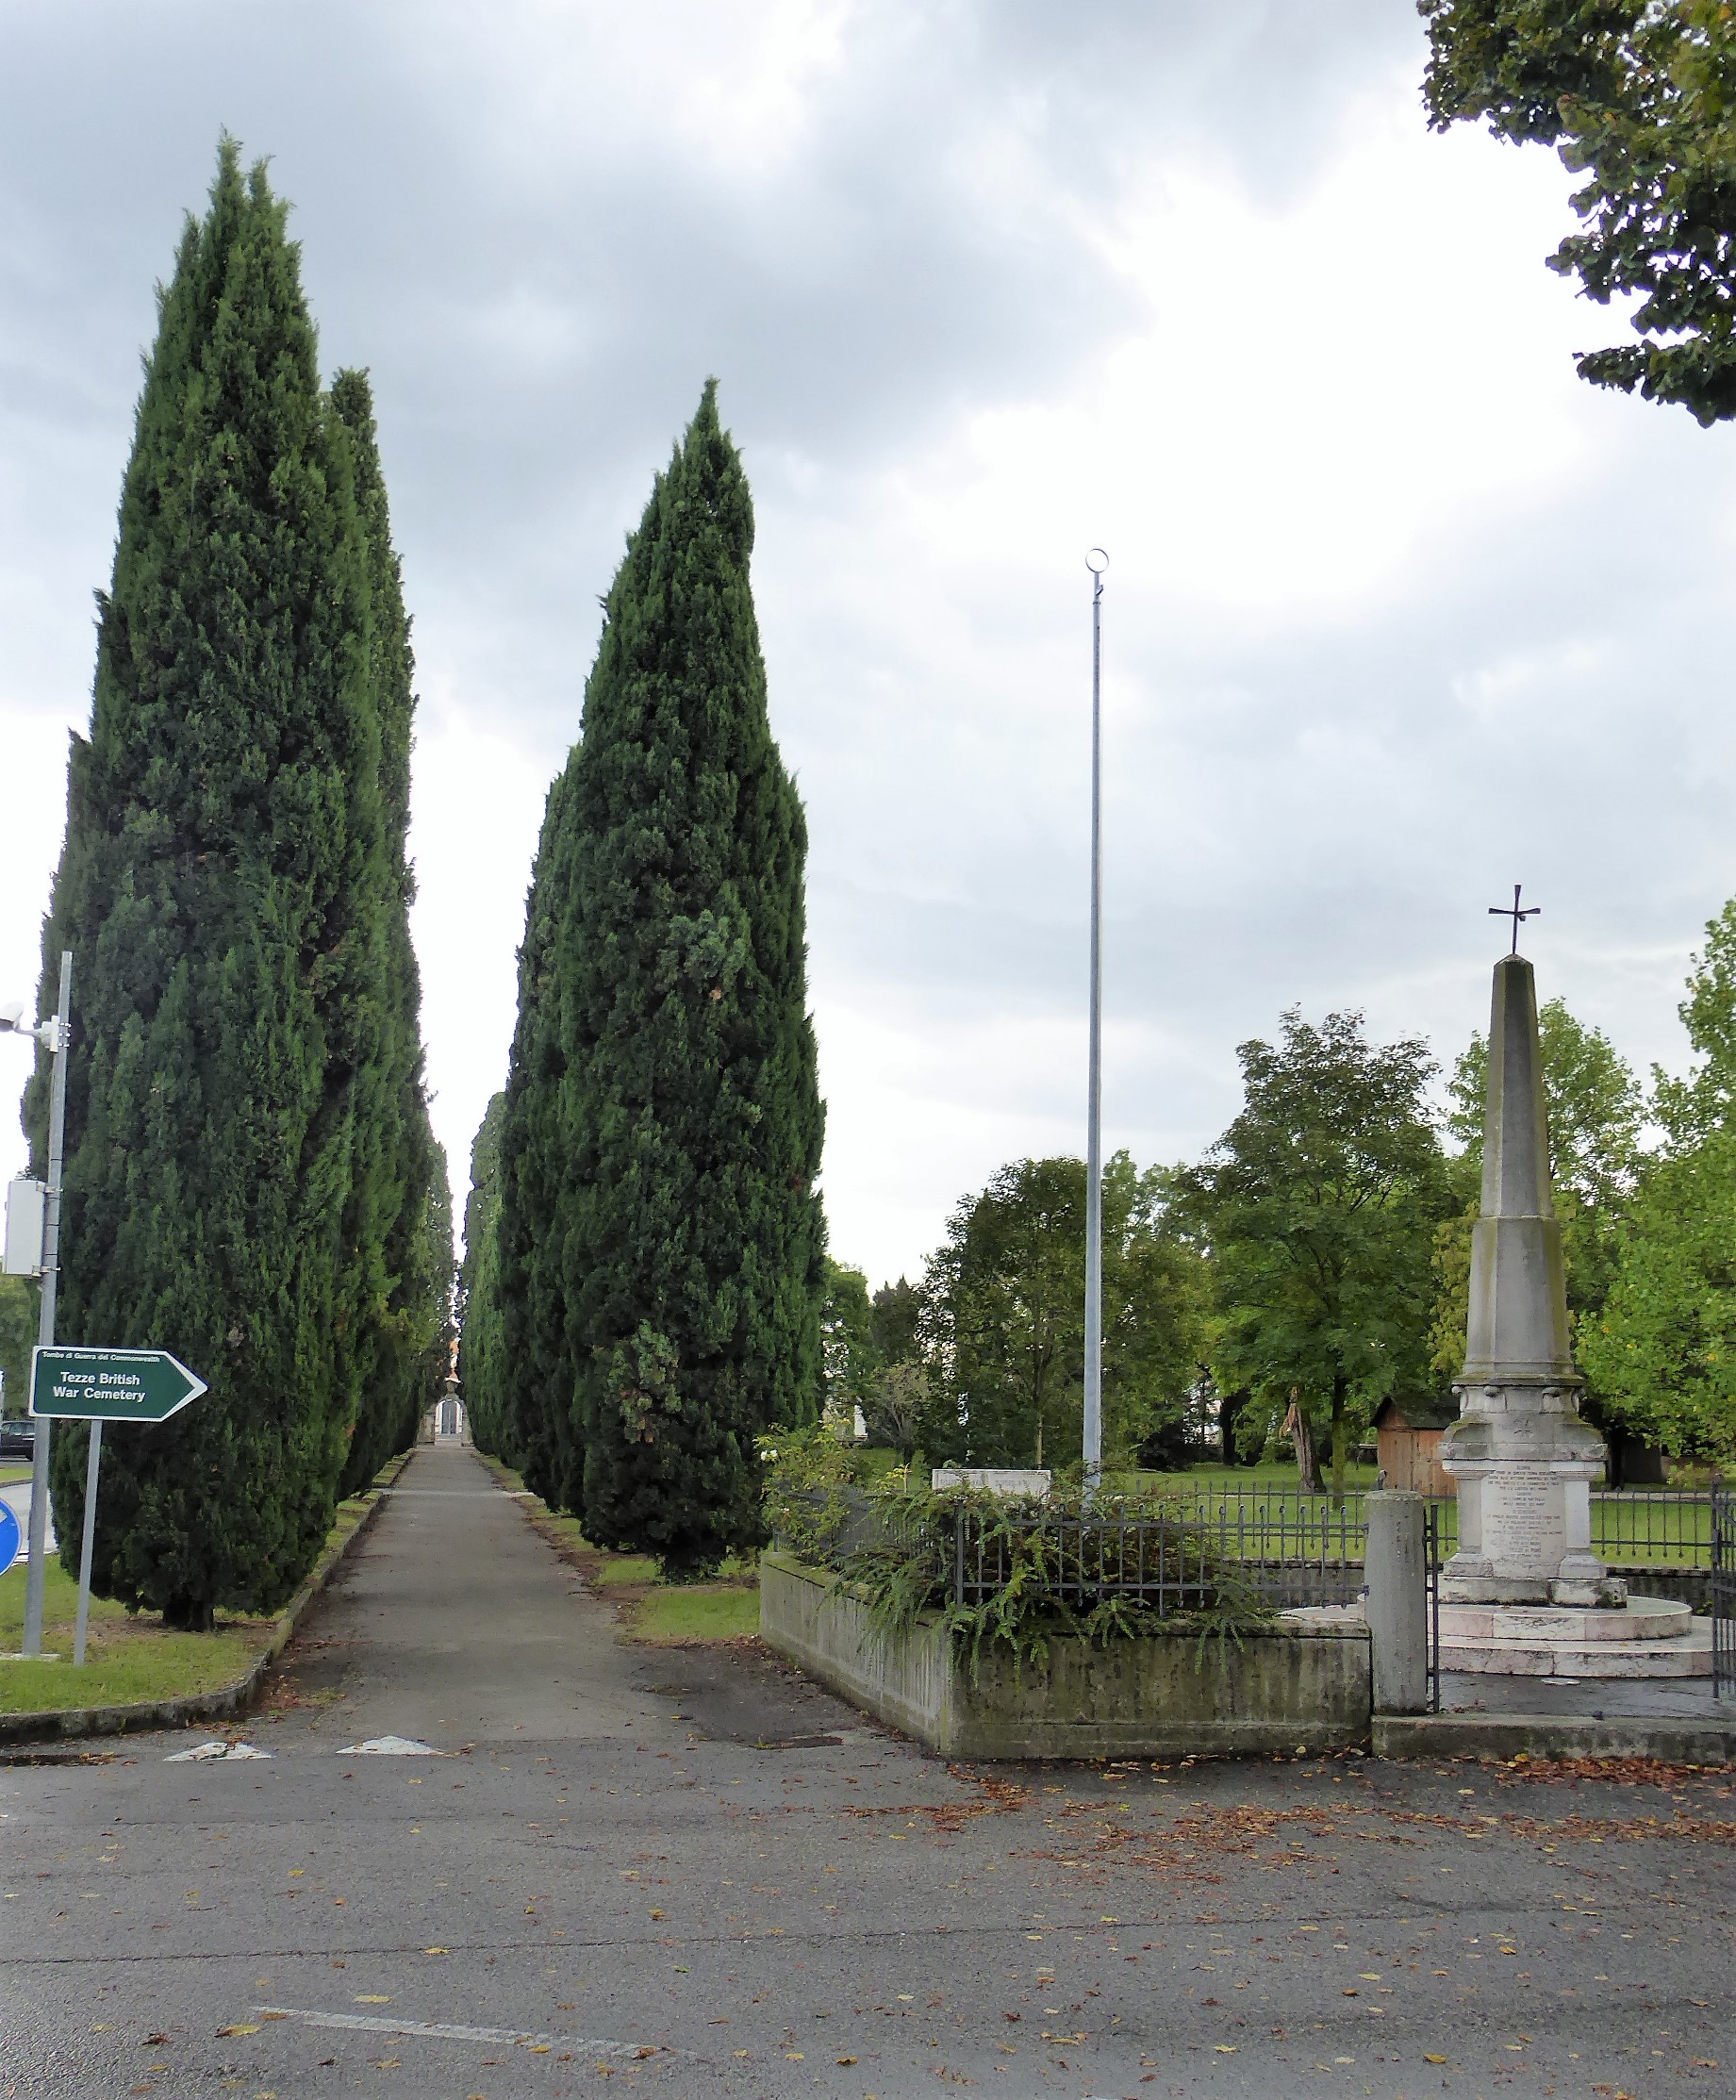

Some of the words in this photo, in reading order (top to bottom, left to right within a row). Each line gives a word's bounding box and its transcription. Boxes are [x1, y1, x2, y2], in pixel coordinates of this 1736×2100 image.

[60, 1371, 96, 1383] Tezze
[99, 1373, 141, 1386] British
[53, 1386, 79, 1397] War
[84, 1387, 145, 1402] Cemetery
